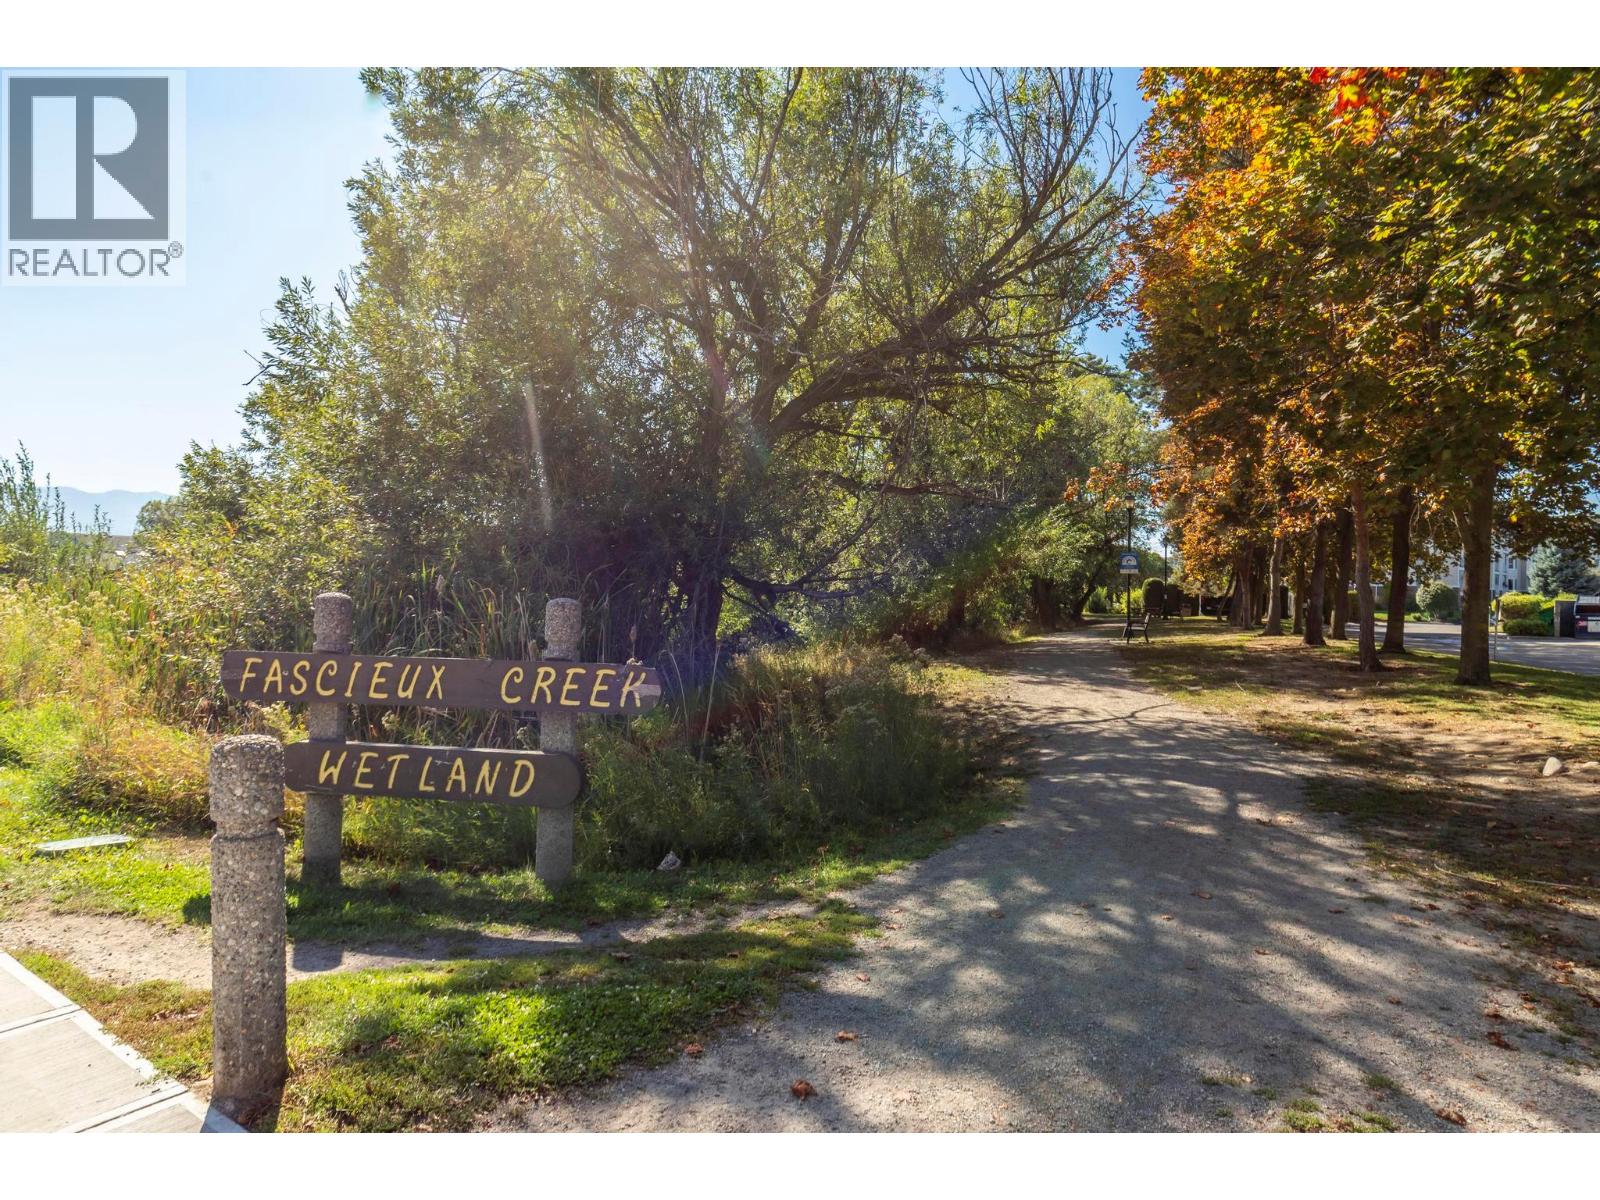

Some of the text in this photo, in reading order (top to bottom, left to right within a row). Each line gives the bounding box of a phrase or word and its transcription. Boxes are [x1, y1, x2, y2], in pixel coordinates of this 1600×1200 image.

[240, 657, 647, 709] FASCIEUX CREEK
[318, 750, 535, 798] WETLAND
